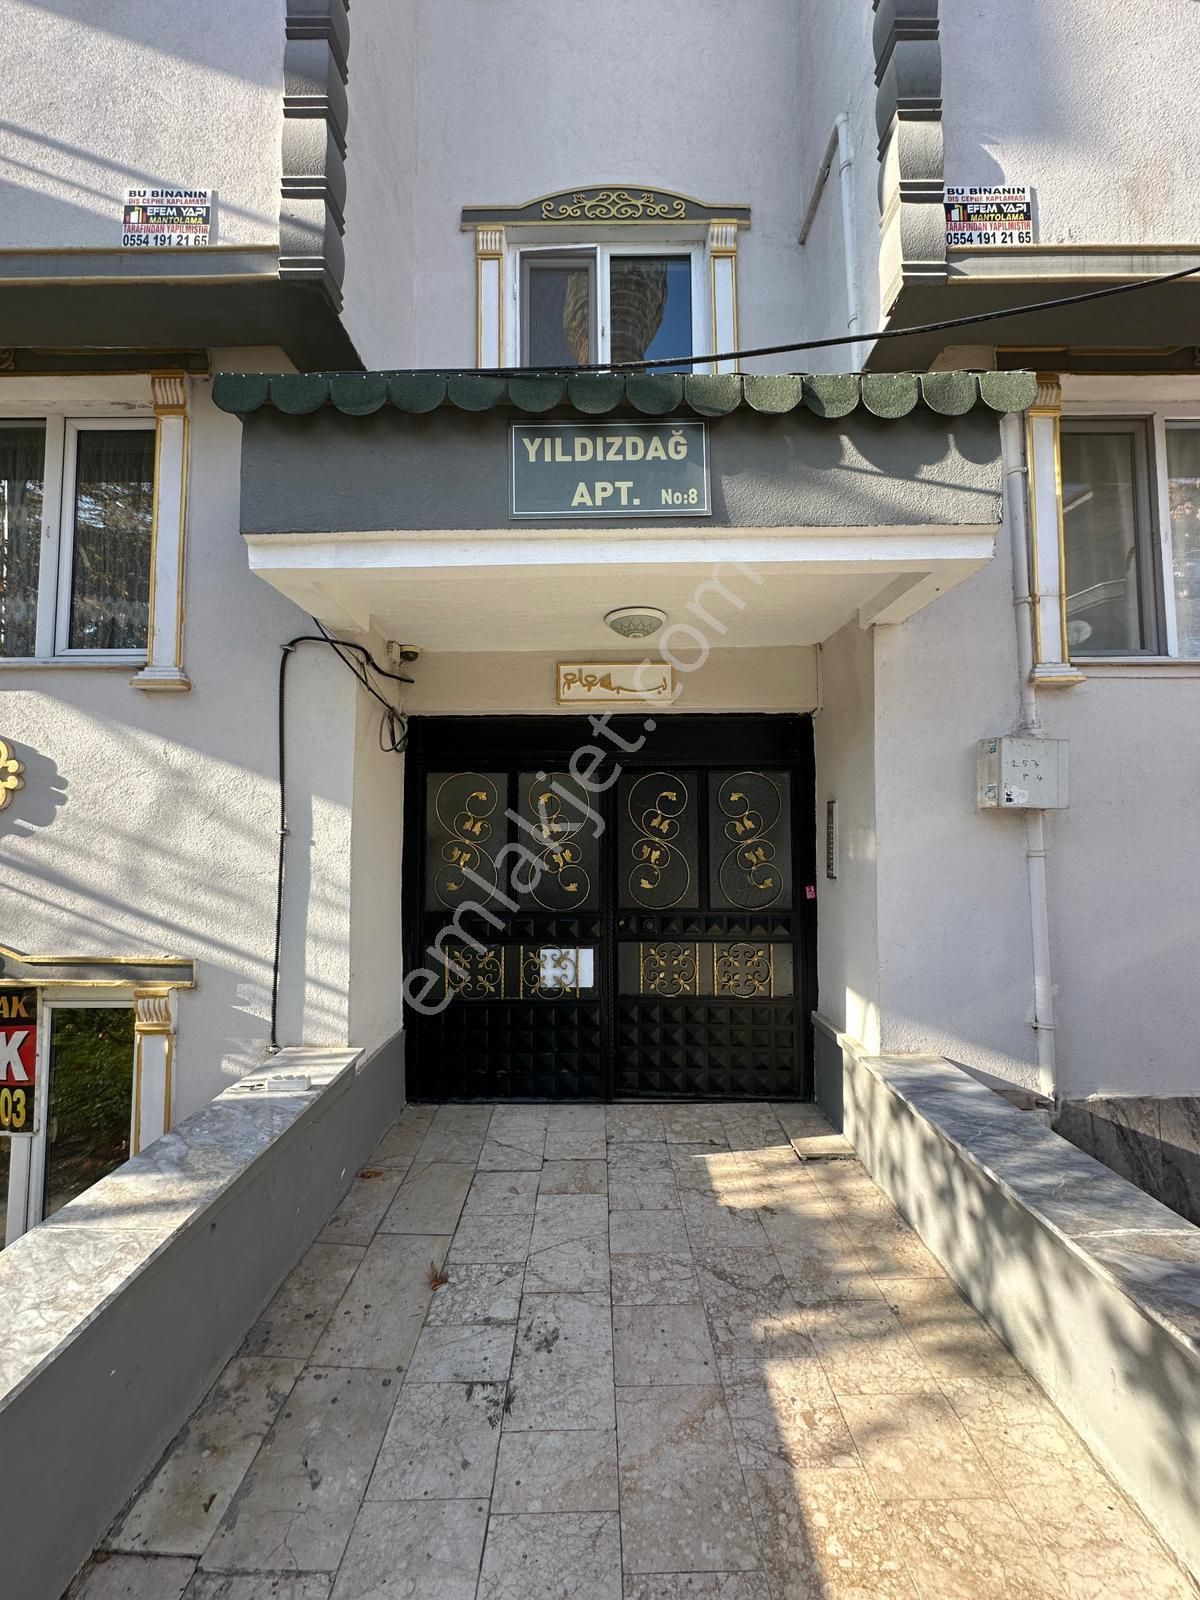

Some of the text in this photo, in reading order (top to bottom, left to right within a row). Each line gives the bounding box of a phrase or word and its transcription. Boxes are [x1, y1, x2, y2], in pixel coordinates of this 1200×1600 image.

[129, 189, 207, 198] BU BİNANIN
[946, 186, 1026, 195] BU BİNANIN
[147, 206, 206, 216] EFEM YAPI
[967, 203, 1027, 213] EFEM YAPI
[149, 216, 203, 224] MANTOLAMA
[970, 213, 1025, 222] MANTOLAMA
[123, 224, 209, 235] TARAFINDAN YAPILMIŞTIR
[946, 221, 1031, 232] TARAFINDAN YAPILMIŞTIR
[123, 234, 207, 246] 0554 191 21 65
[946, 231, 1031, 245] 0554 191 21 65
[522, 429, 688, 463] YILDIZDAĞ
[571, 481, 698, 507] APT. No:8
[0, 1030, 30, 1081] K
[0, 1087, 26, 1128] 03
